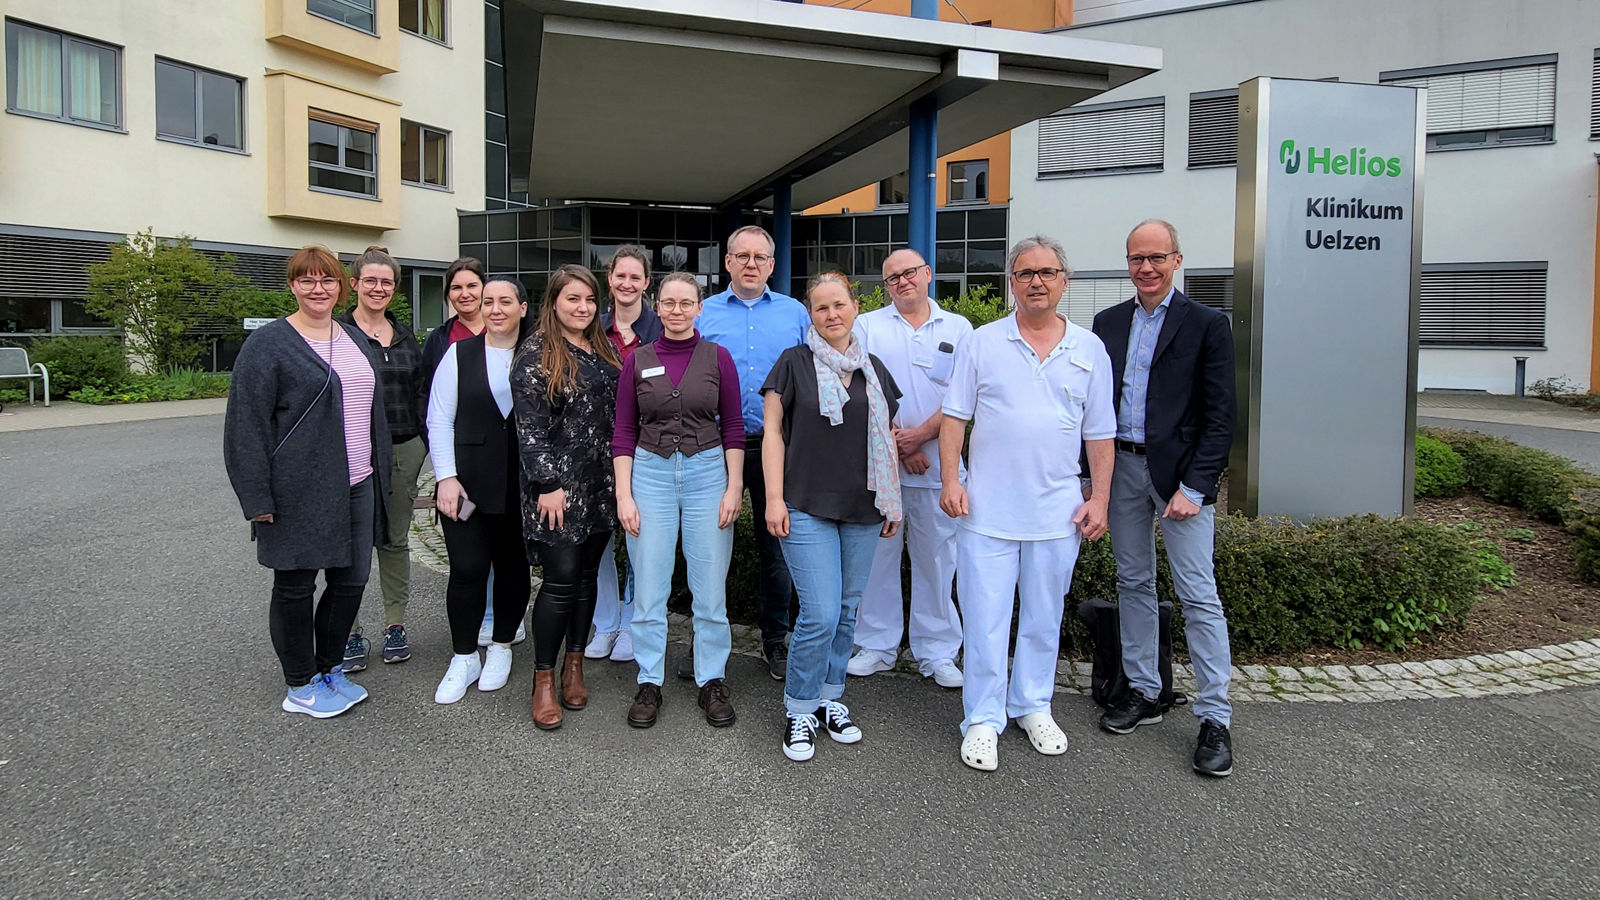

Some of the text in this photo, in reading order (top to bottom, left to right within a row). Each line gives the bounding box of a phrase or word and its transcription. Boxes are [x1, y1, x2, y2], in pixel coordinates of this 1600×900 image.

[1307, 147, 1401, 177] Helios
[1306, 197, 1403, 220] Klinikum
[1305, 229, 1381, 251] Uelzen
